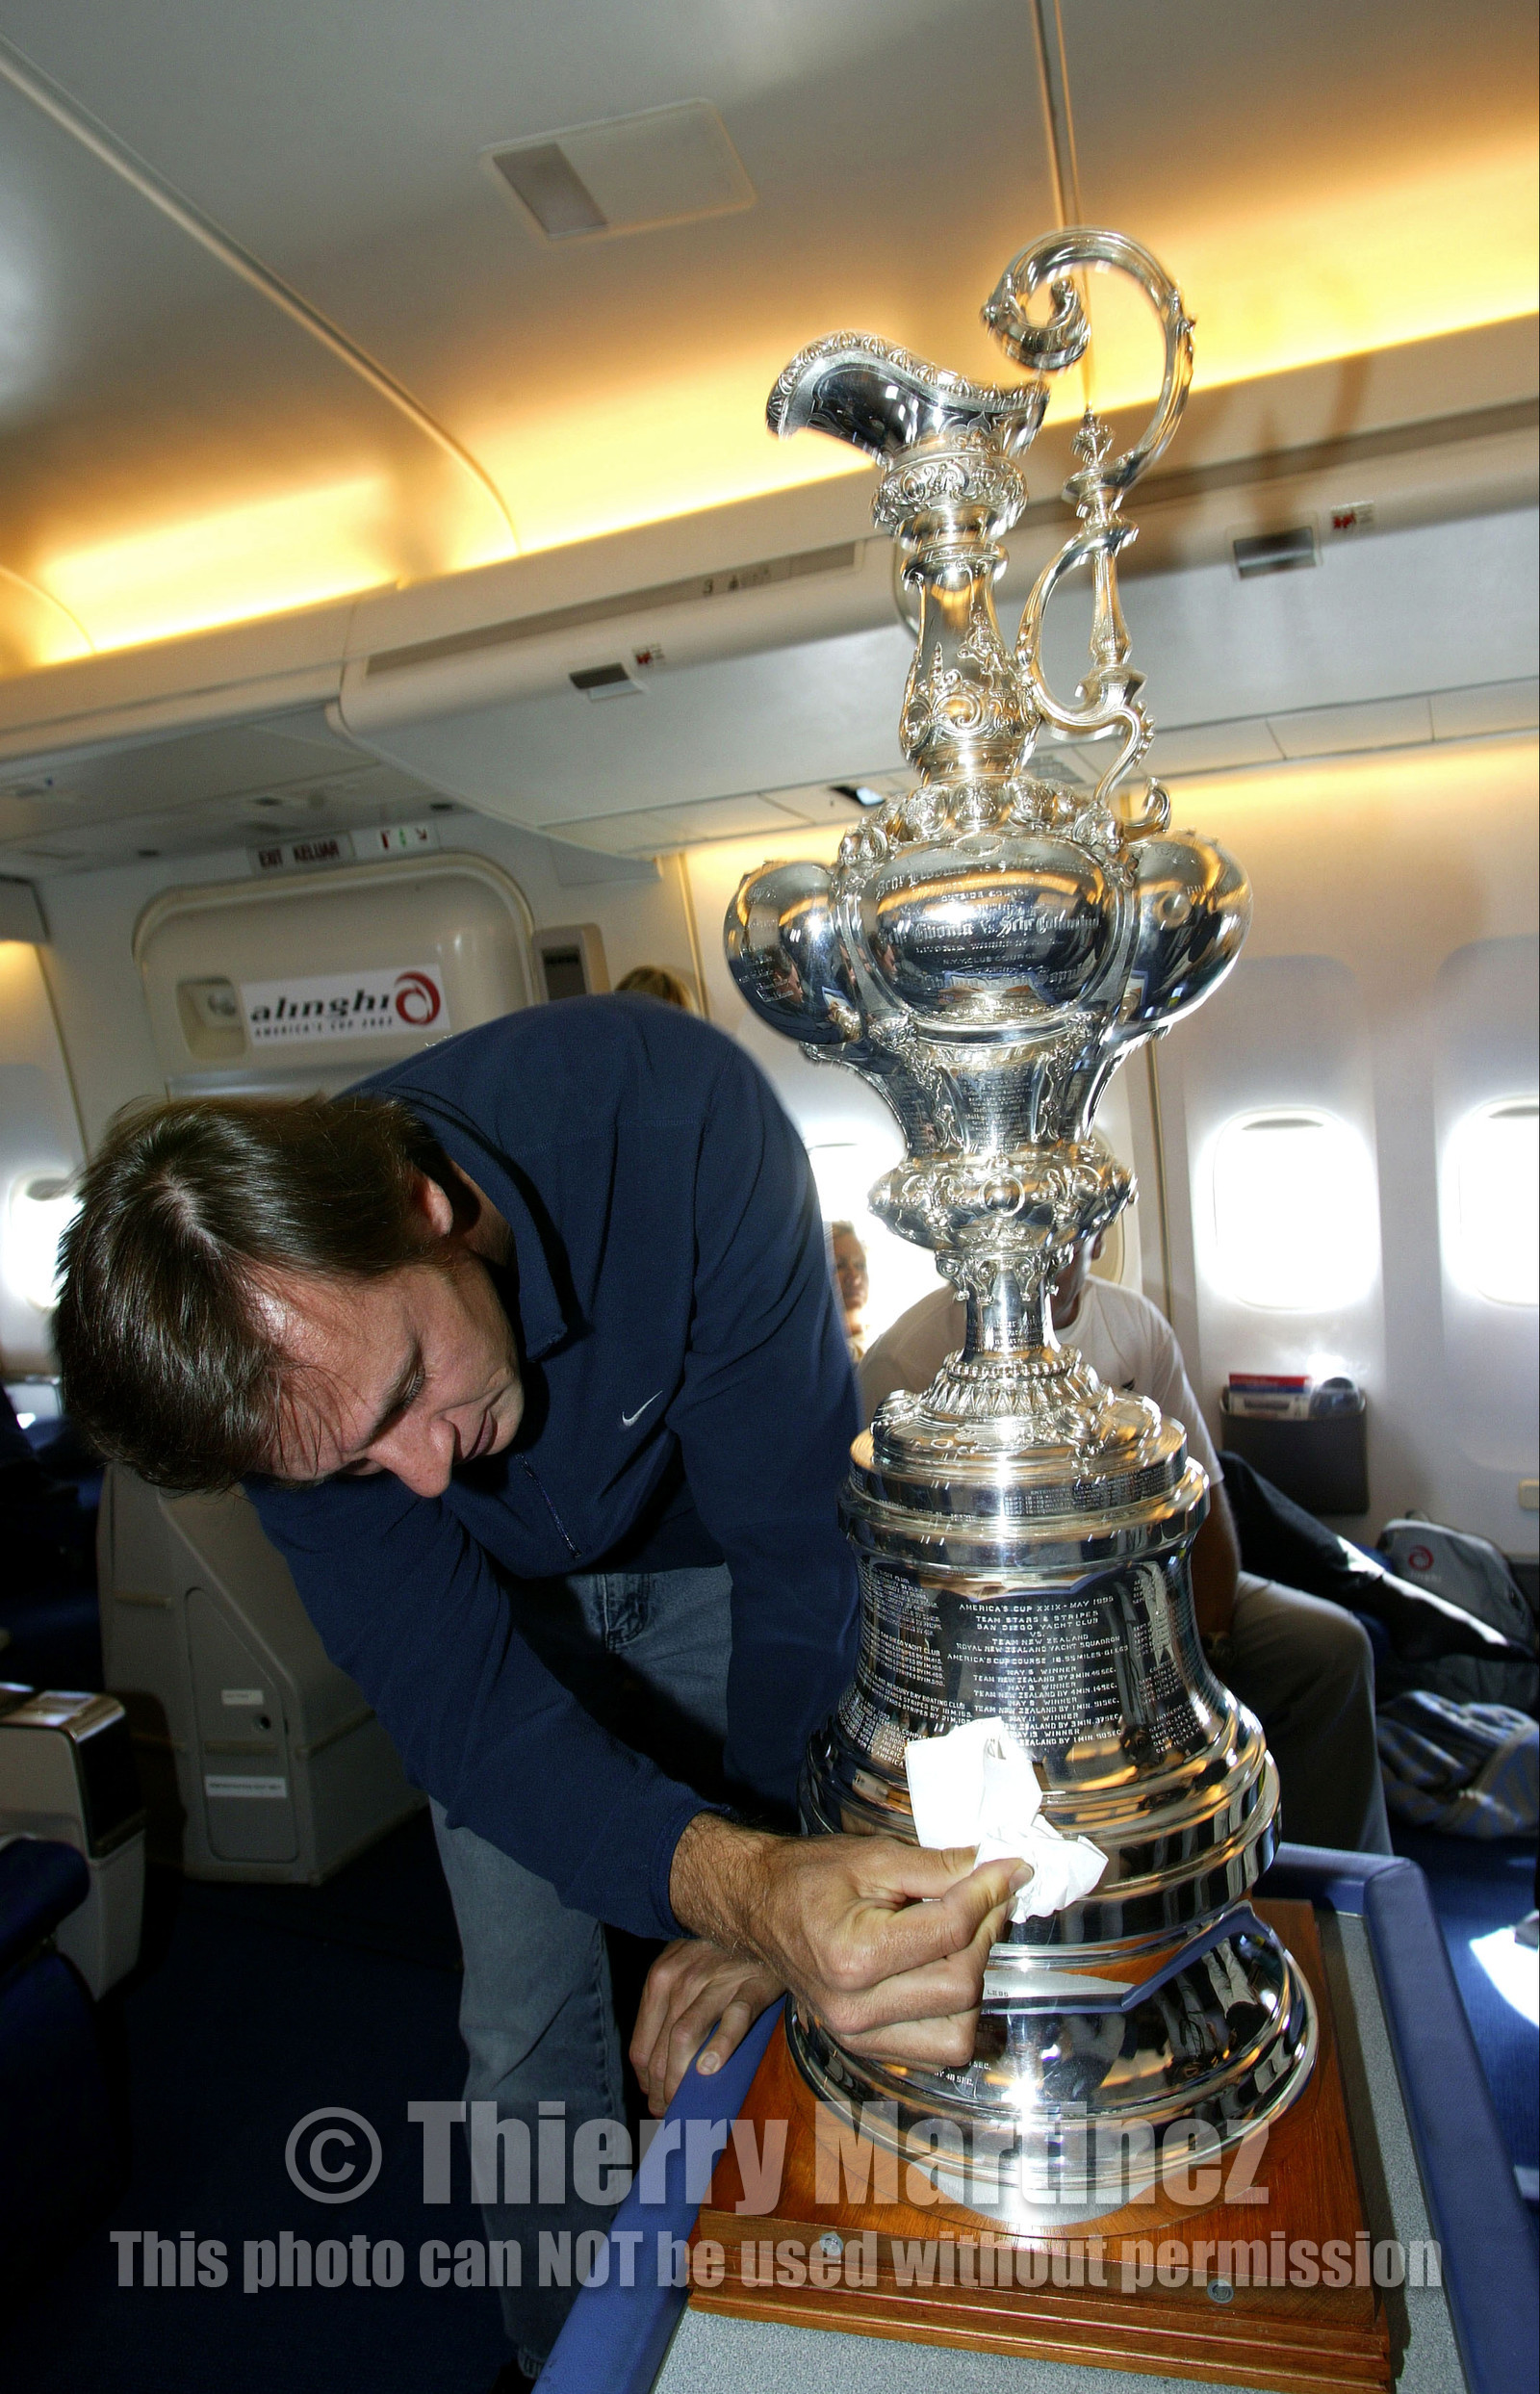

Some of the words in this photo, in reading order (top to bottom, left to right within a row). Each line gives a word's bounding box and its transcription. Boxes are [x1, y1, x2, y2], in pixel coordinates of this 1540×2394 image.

[258, 848, 283, 868] EXIT
[293, 839, 339, 863] KELUAR
[250, 990, 390, 1021] alinghi
[959, 1604, 1009, 1612] AMERICA'S
[1037, 1604, 1062, 1612] XXIX
[1069, 1600, 1090, 1609] MAY
[1054, 1610, 1099, 1622] STRIPES
[1040, 1621, 1072, 1630] YACHT
[1075, 1617, 1099, 1627] CLUB
[956, 1642, 982, 1652] ROYAL
[1048, 1643, 1077, 1652] YACHT
[1079, 1635, 1120, 1649] SQUADRON
[1046, 1634, 1089, 1643] ZEALAND
[924, 1647, 940, 1657] CLUB
[947, 1653, 991, 1664] AMERICA'S
[992, 1657, 1011, 1665] CUP
[1040, 1665, 1076, 1675] WINNER
[973, 1674, 995, 1683] TEAM
[1041, 1681, 1076, 1690] WINNER
[922, 1694, 947, 1707] BOATING
[949, 1701, 964, 1710] CLUB
[1043, 1696, 1077, 1706] WINNER
[930, 1712, 939, 1720] BY
[1042, 1712, 1079, 1721] WINNER
[1019, 1722, 1057, 1731] ZEALAND
[1043, 1728, 1080, 1738] WINNER
[973, 2060, 991, 2071] SEC.
[956, 2075, 974, 2086] SEC.
